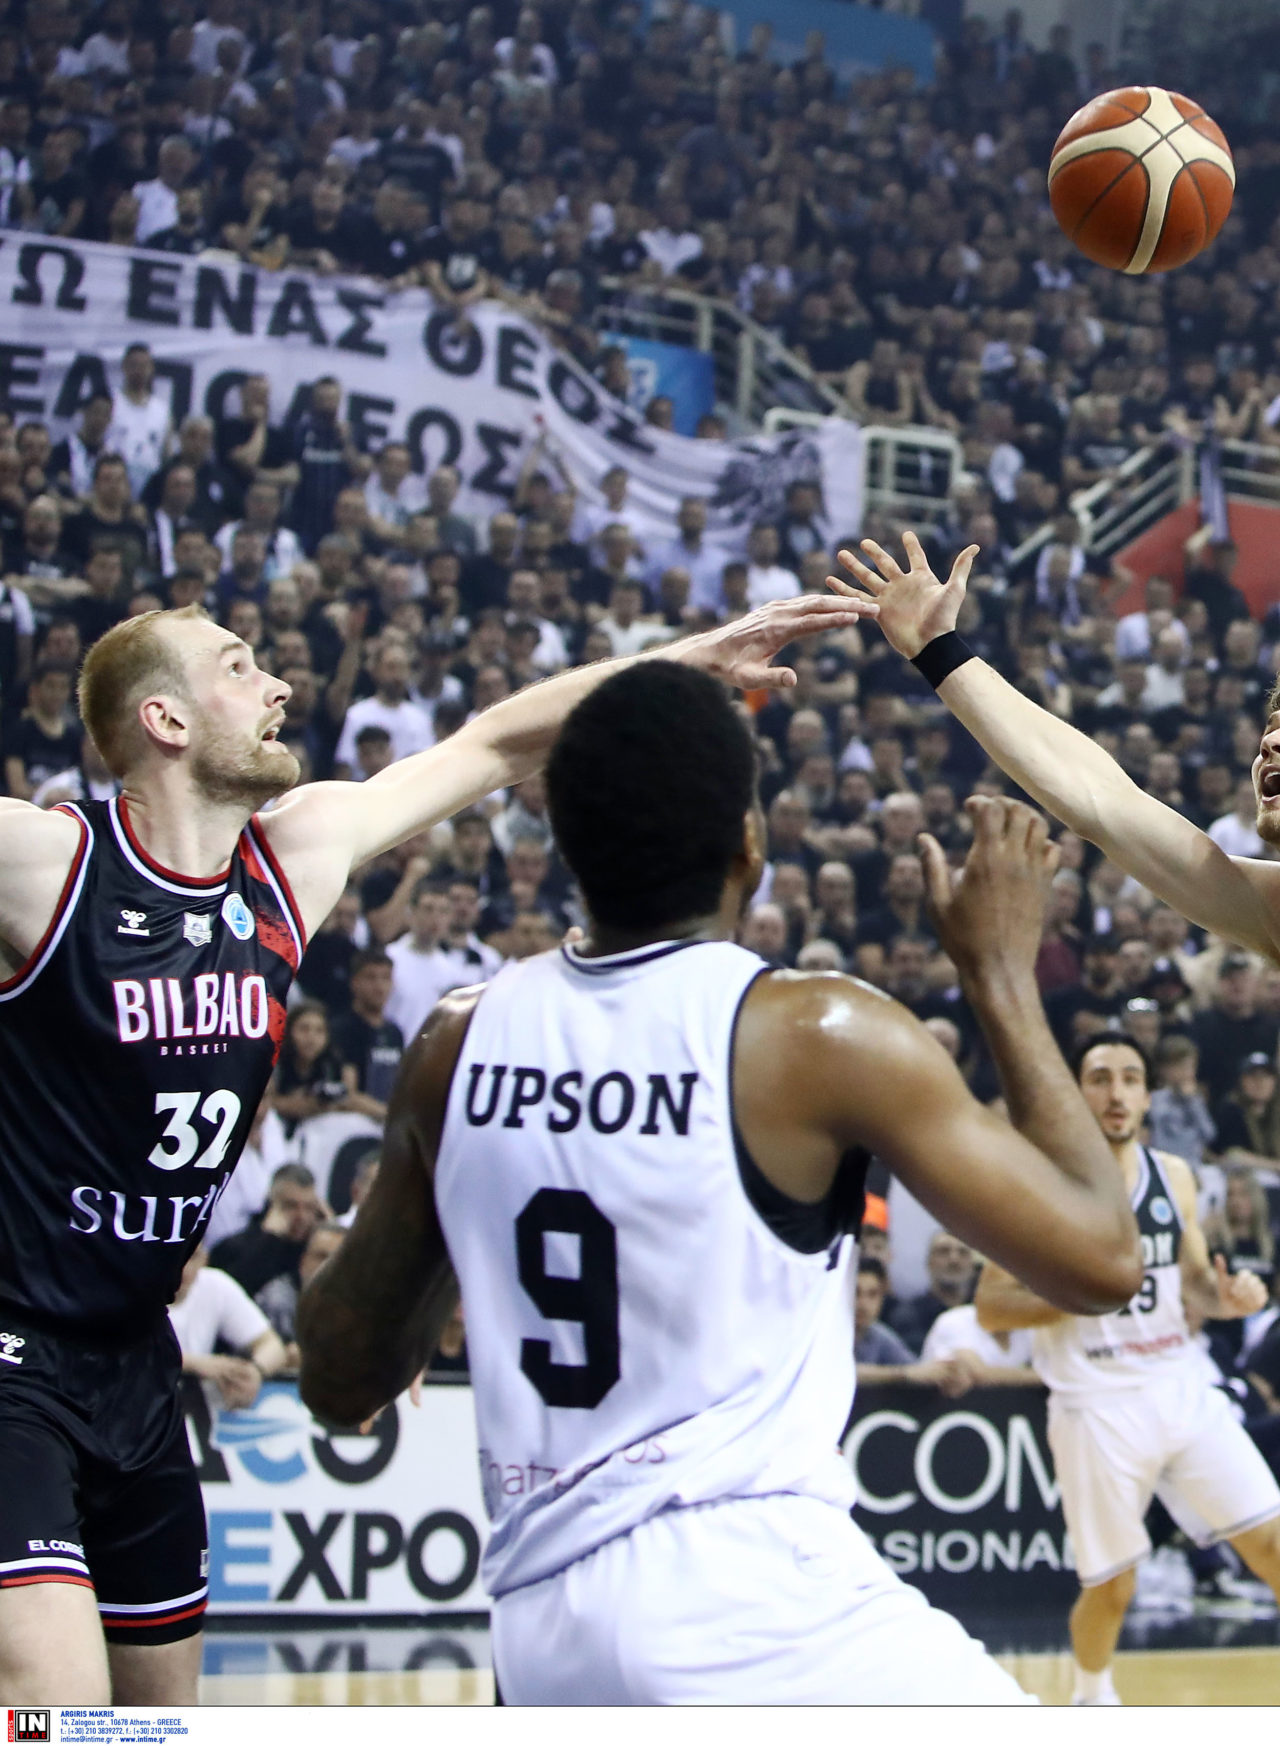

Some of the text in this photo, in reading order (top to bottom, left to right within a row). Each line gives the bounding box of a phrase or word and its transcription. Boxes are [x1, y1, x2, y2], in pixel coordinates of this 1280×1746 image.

[0, 238, 87, 312] Ω
[112, 971, 270, 1043] BILBAO
[160, 1043, 228, 1056] BASKET
[147, 1089, 242, 1171] 32
[464, 1062, 699, 1137] UPSON
[69, 1172, 231, 1243] sur
[515, 1186, 623, 1410] 9
[208, 1510, 481, 1602] EXPO
